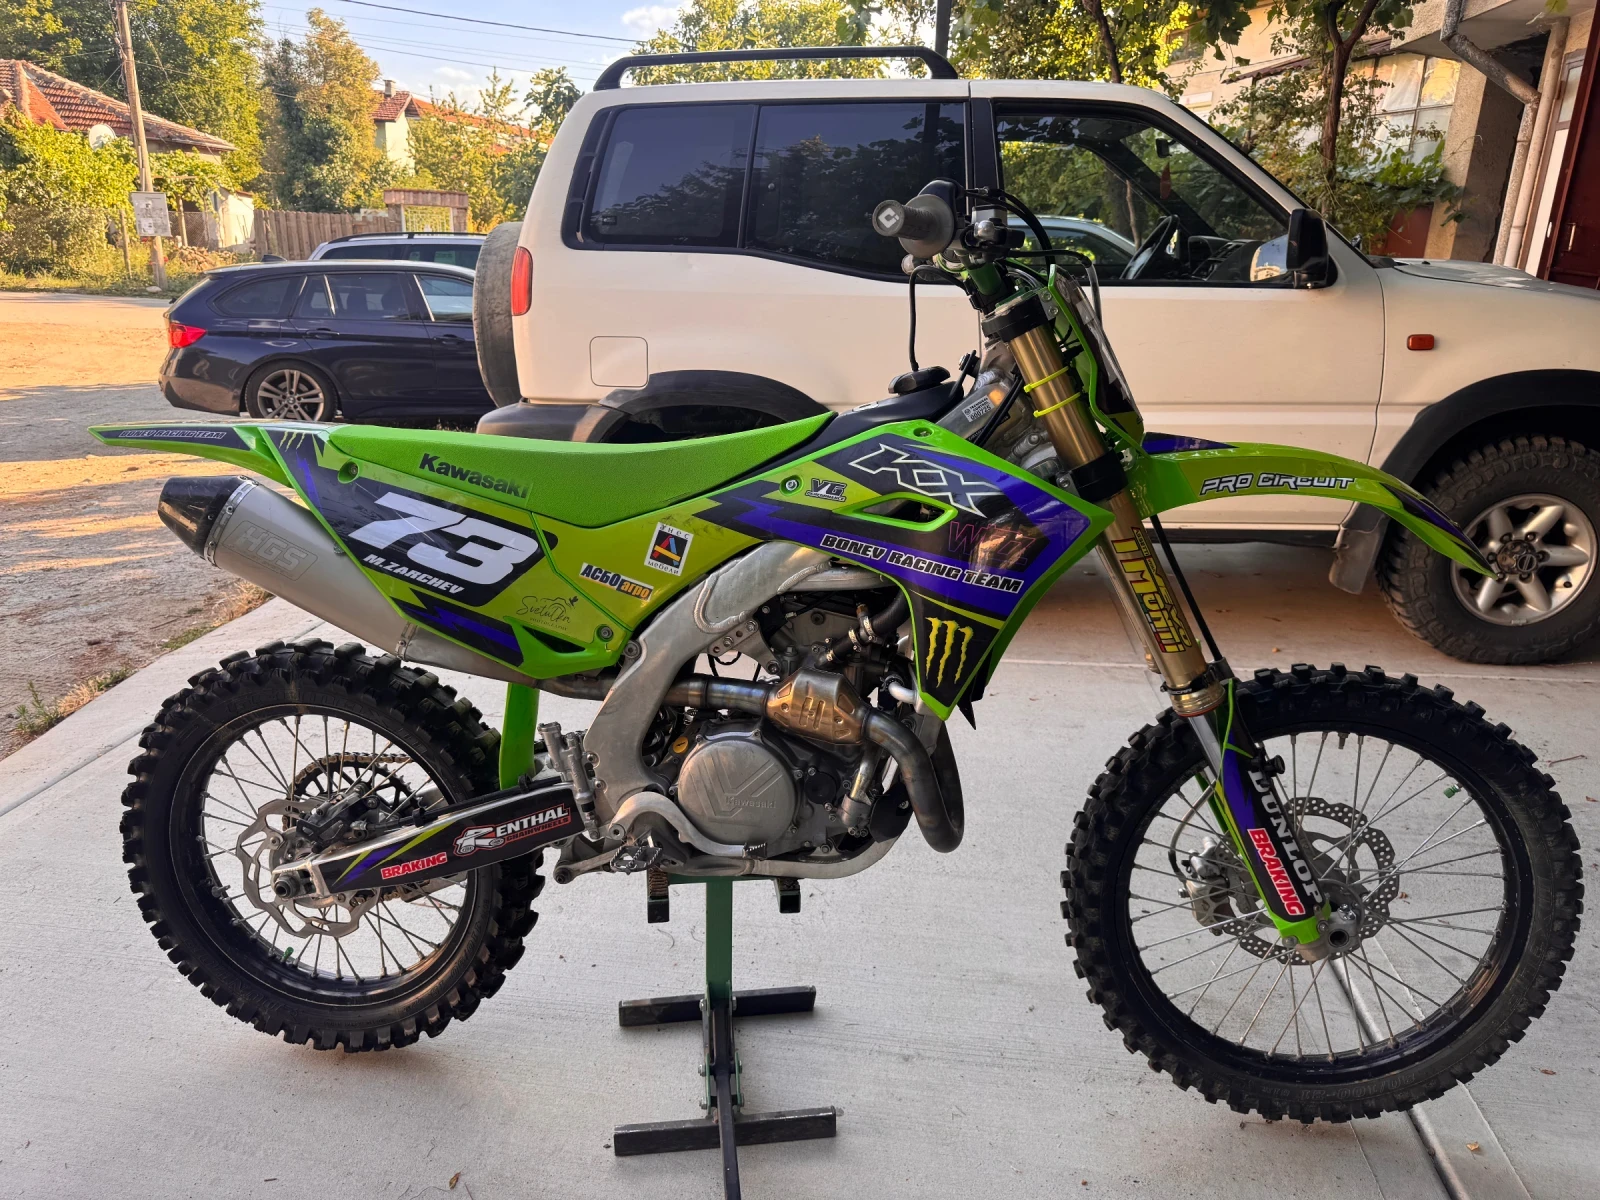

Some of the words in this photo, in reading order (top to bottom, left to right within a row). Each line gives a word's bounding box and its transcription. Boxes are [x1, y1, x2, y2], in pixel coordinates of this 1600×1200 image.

[153, 430, 197, 438] RACING
[194, 431, 227, 439] TEAM
[419, 452, 530, 499] Kawasaki
[1200, 474, 1254, 496] PRO
[1257, 472, 1355, 490] CIRCUIT
[235, 525, 309, 572] HGS
[348, 491, 539, 585] 73
[363, 552, 464, 595] M.ZARCHEV
[820, 533, 888, 561] BONEV
[886, 550, 963, 581] RACING
[961, 569, 1025, 594] TEAM
[456, 806, 569, 855] RENTHAL
[506, 816, 571, 841] CHAINWHEELS
[1247, 769, 1324, 904] DUNLOP
[380, 851, 448, 880] BRAKING
[1247, 827, 1306, 916] BRAKING
